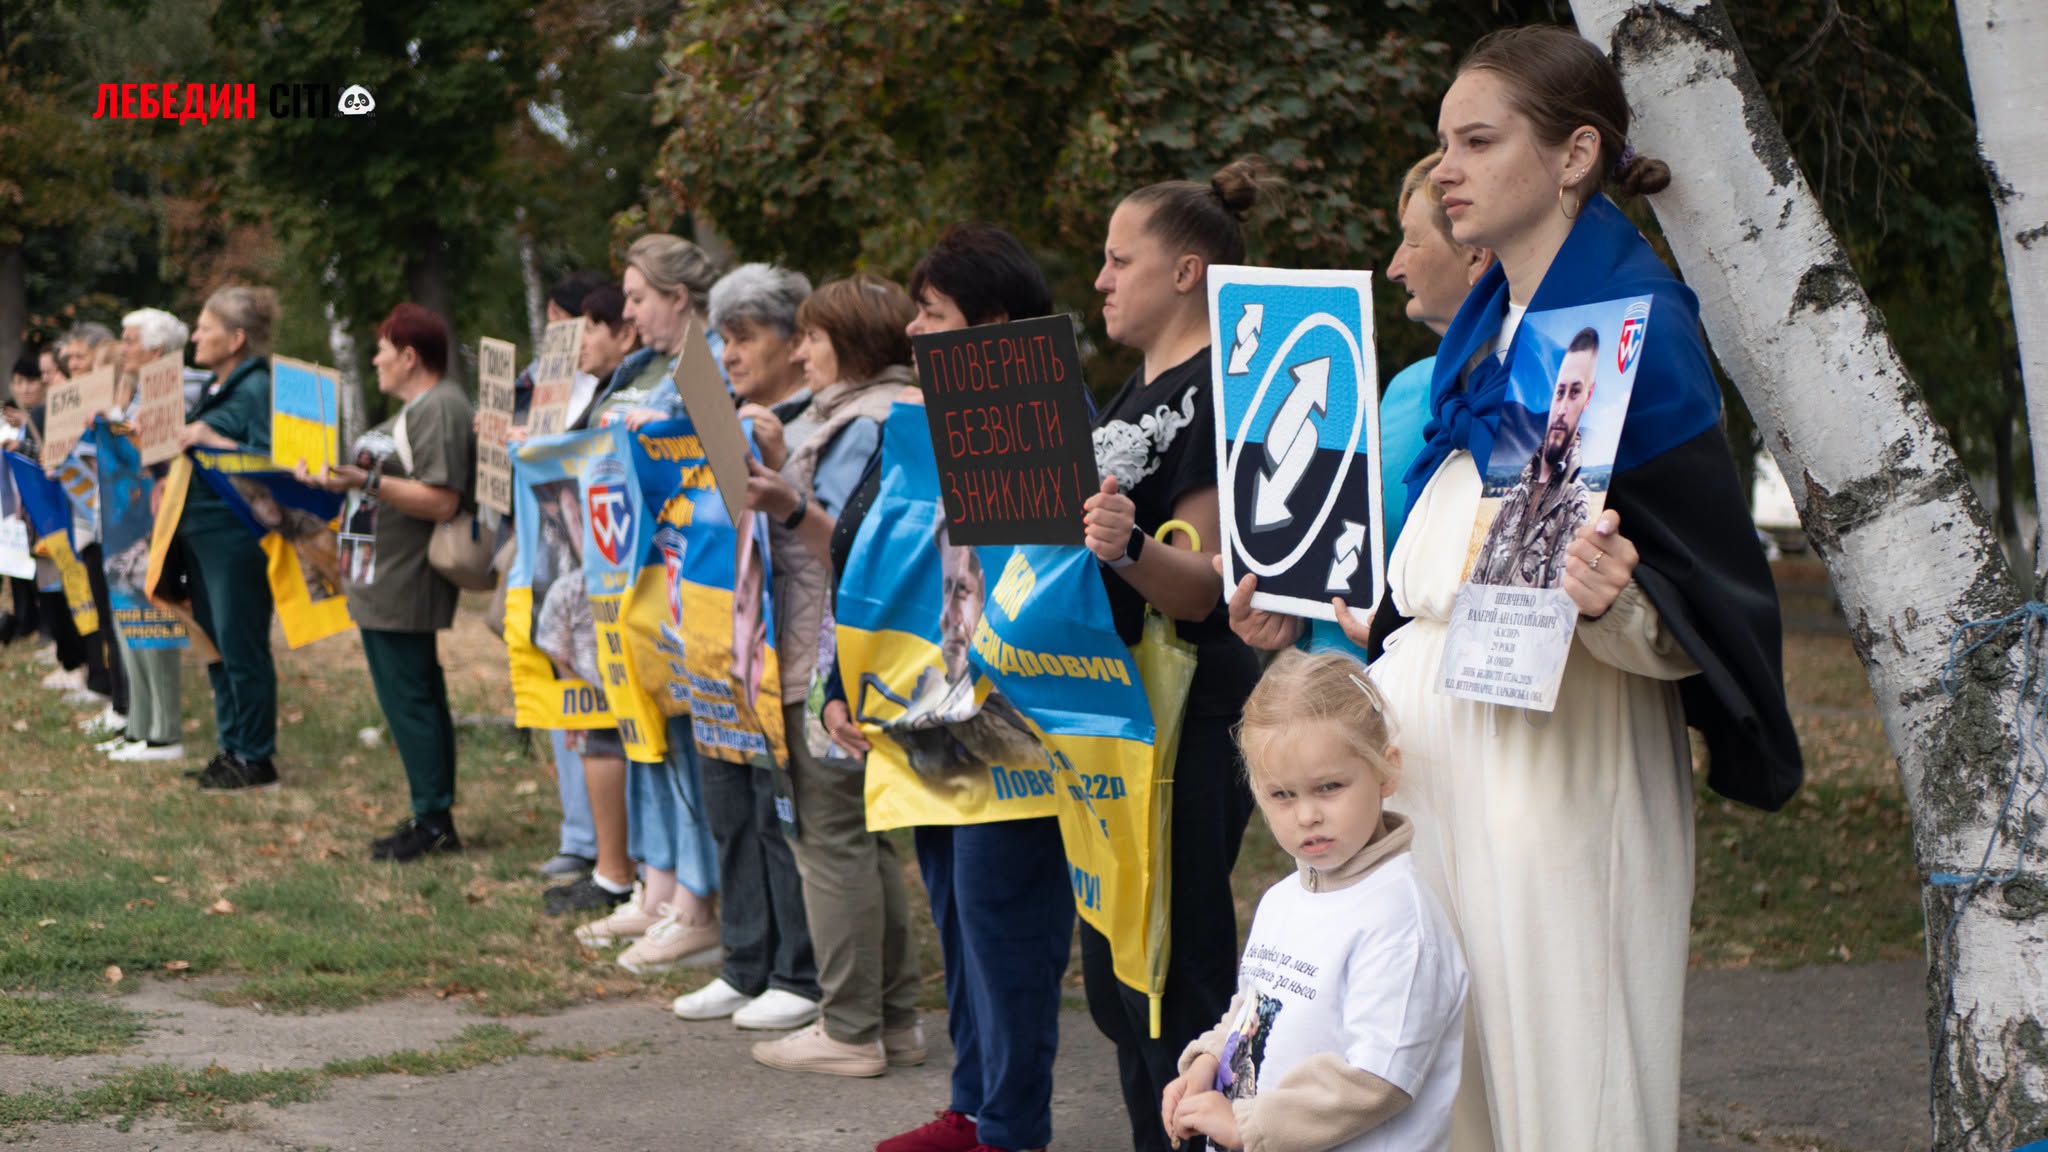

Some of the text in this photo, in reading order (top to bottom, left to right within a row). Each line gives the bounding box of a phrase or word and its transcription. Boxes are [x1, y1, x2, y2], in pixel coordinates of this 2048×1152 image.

[929, 336, 1065, 394] ПОВЕРНІТЬ
[945, 399, 1063, 458] БЕЗВІСТИ
[946, 466, 1067, 523] ЗНИКЛИХ
[1494, 592, 1537, 607] ШЕВЧЕНКО
[1272, 975, 1290, 989] за
[1288, 980, 1317, 1000] нього
